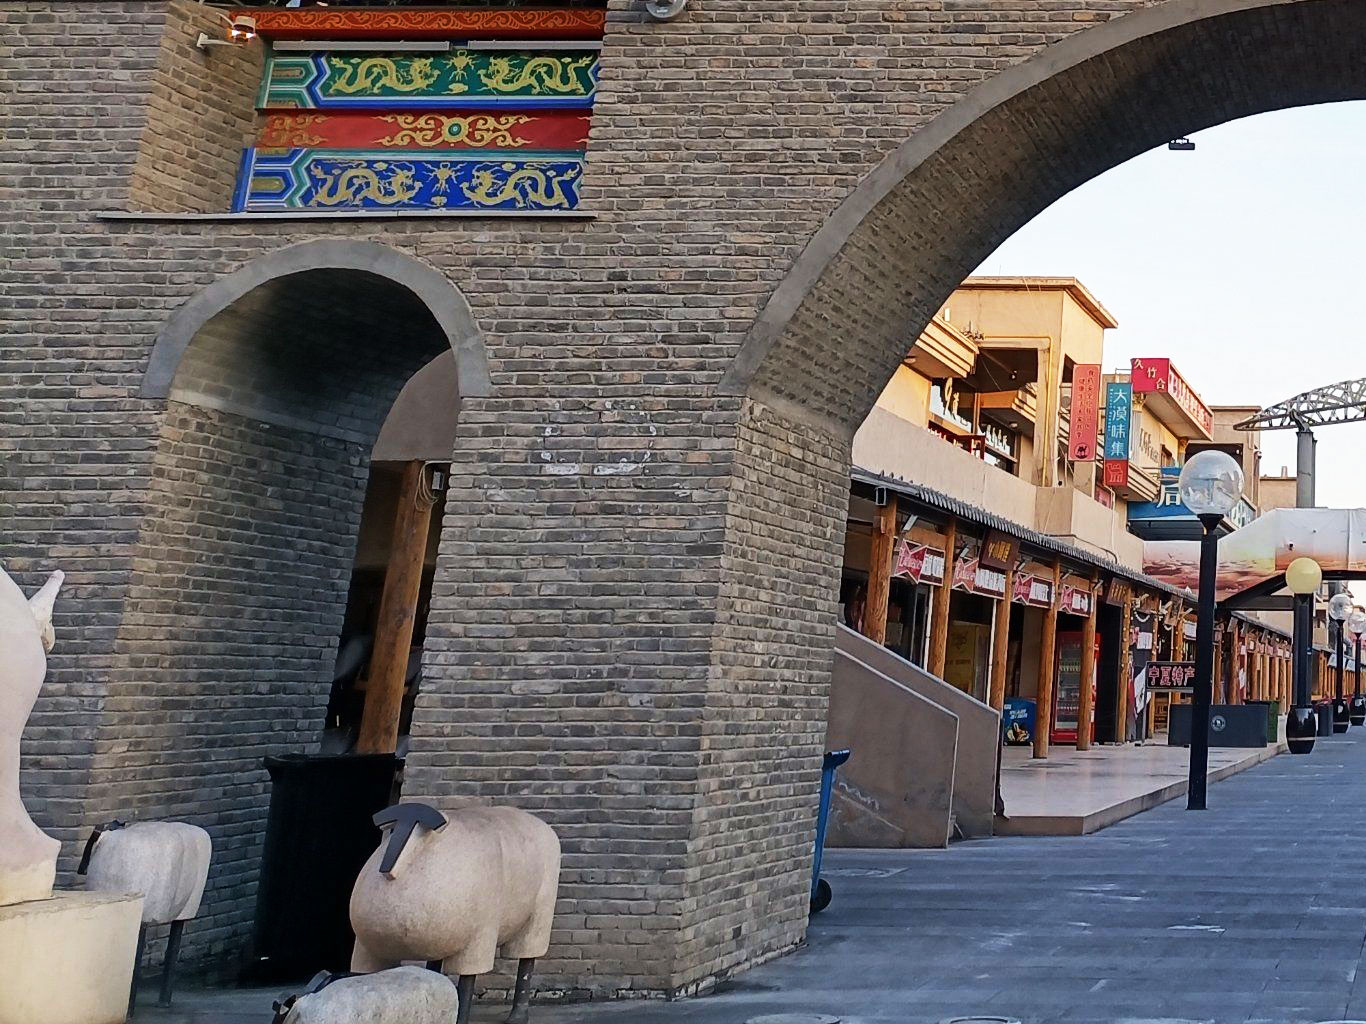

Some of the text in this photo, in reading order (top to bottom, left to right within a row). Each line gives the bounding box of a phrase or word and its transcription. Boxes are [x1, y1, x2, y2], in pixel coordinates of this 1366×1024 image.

[1109, 388, 1129, 456] 大漠味集
[1148, 665, 1196, 687] 宁夏特产
